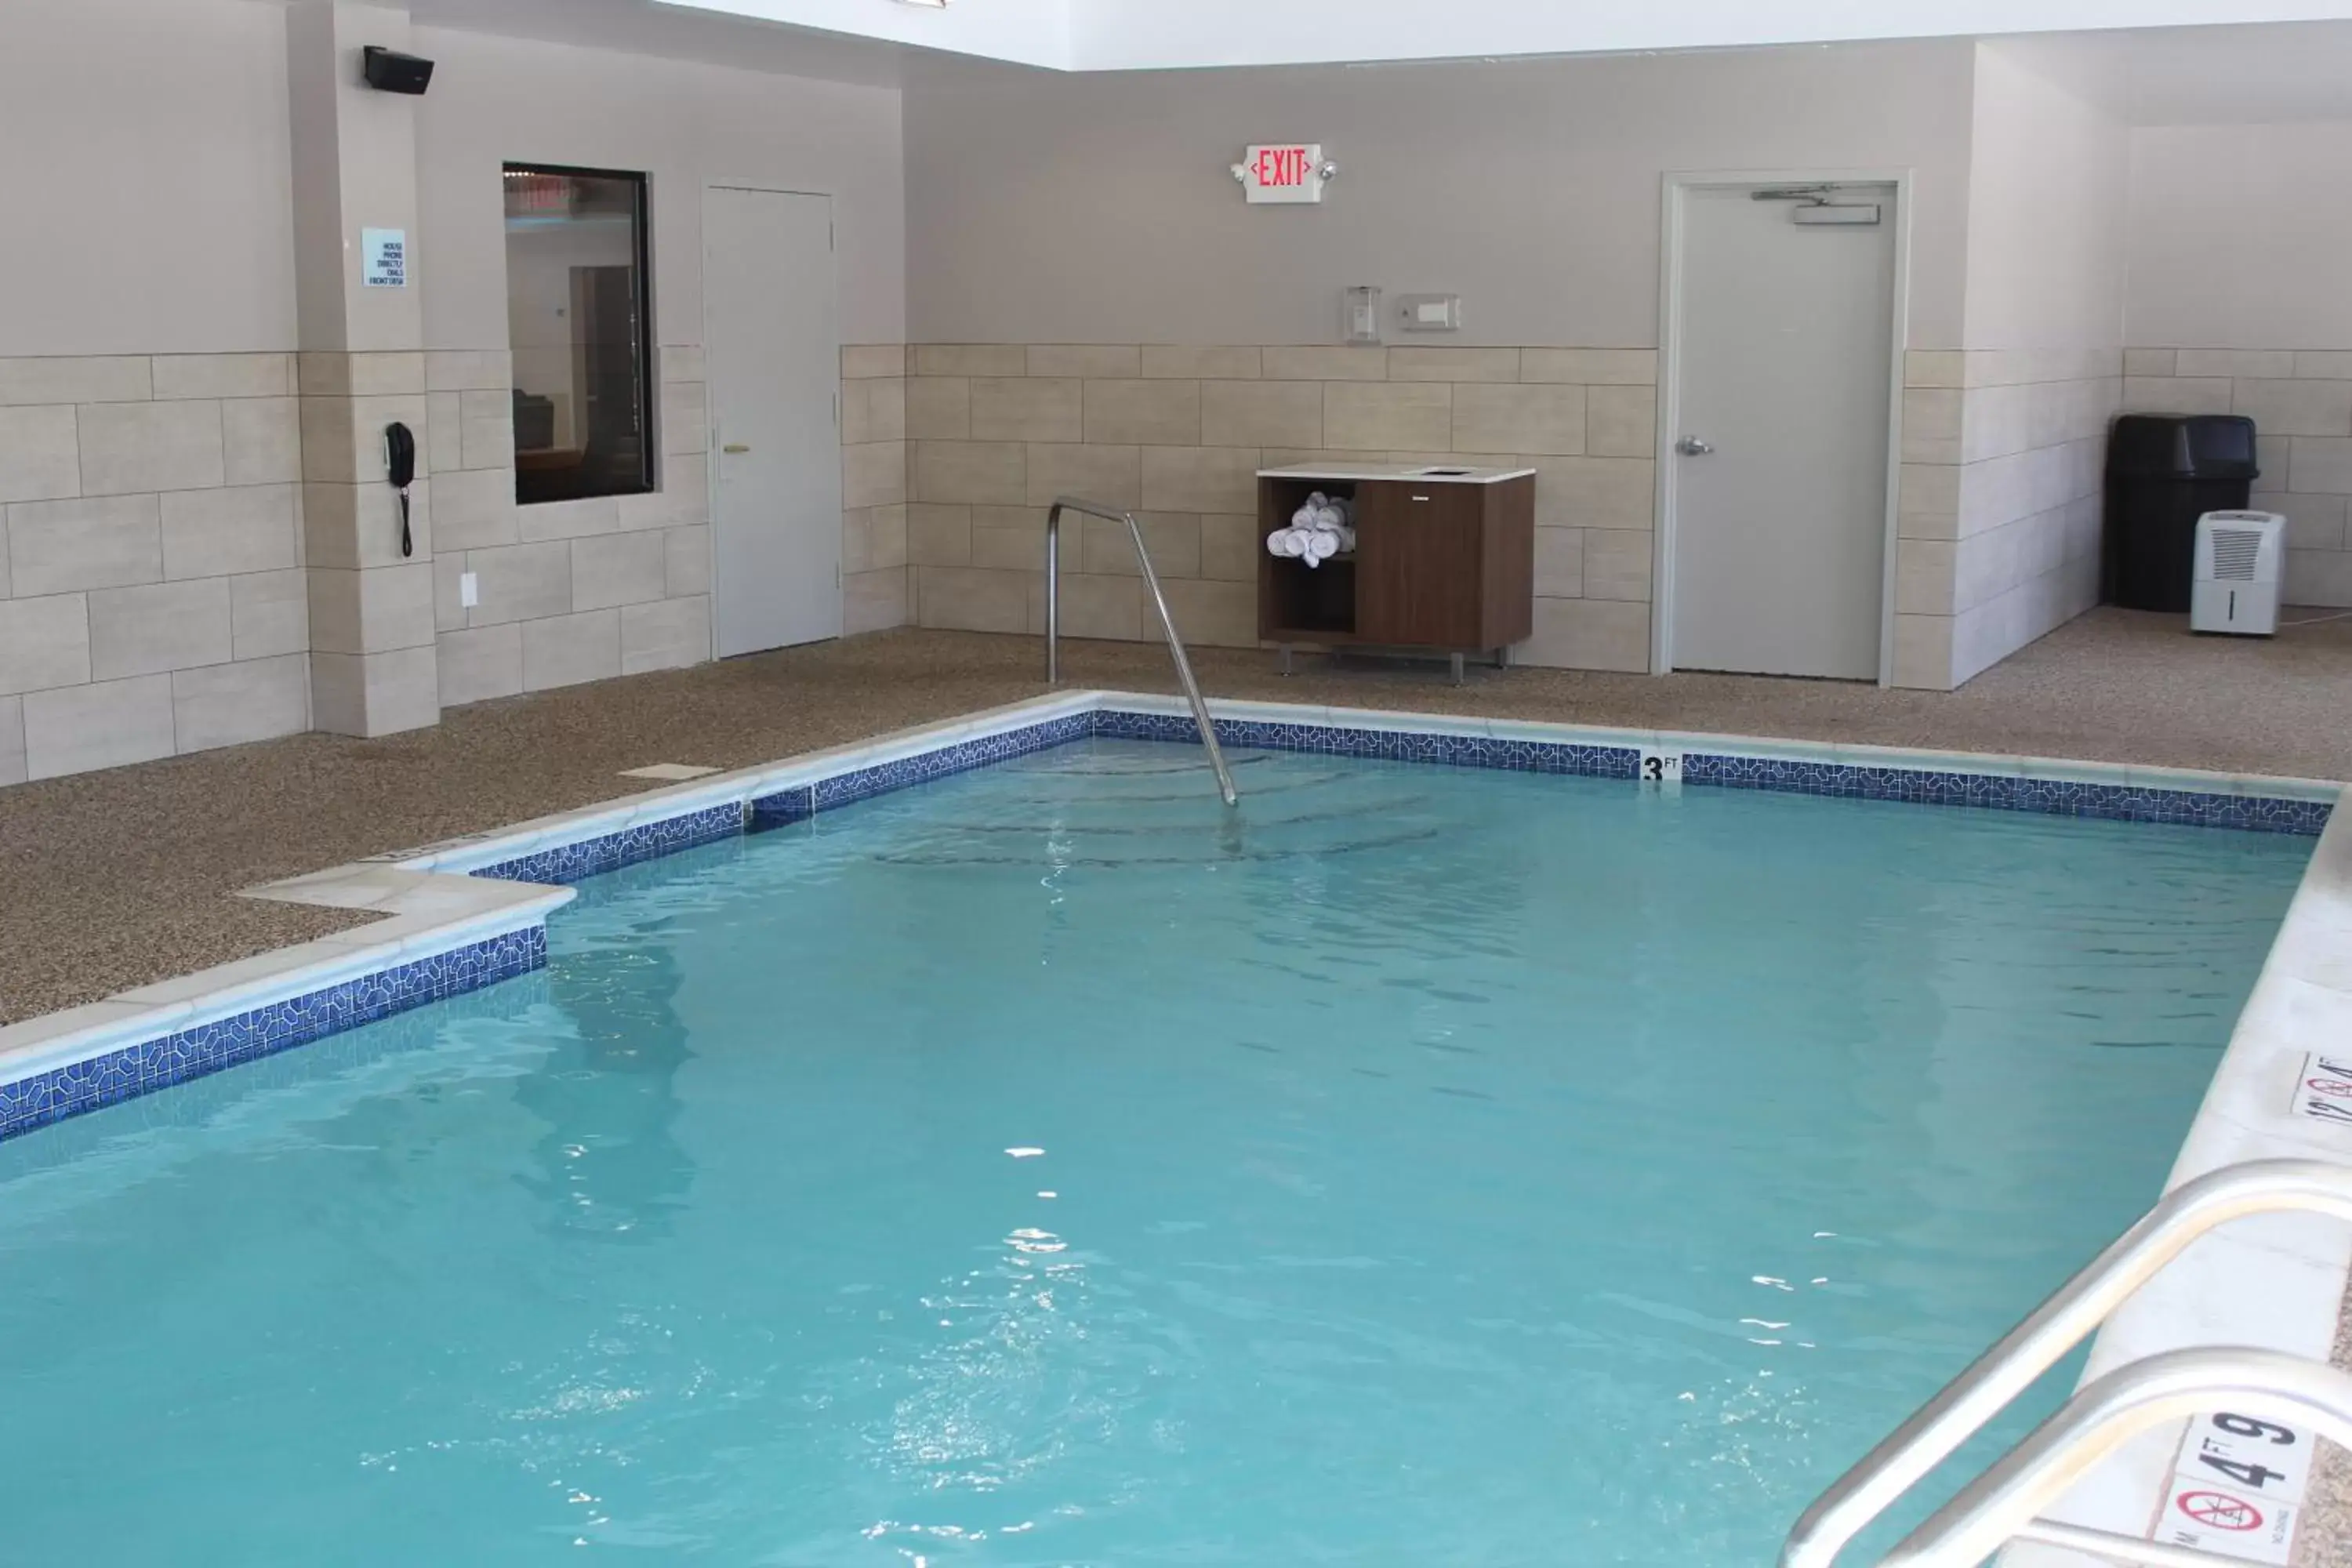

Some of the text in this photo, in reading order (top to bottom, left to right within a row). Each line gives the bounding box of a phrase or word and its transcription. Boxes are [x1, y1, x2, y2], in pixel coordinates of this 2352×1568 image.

[1259, 149, 1305, 186] EXIT
[1644, 757, 1678, 780] 3 FT
[2198, 1411, 2296, 1490] 4 FT 9
